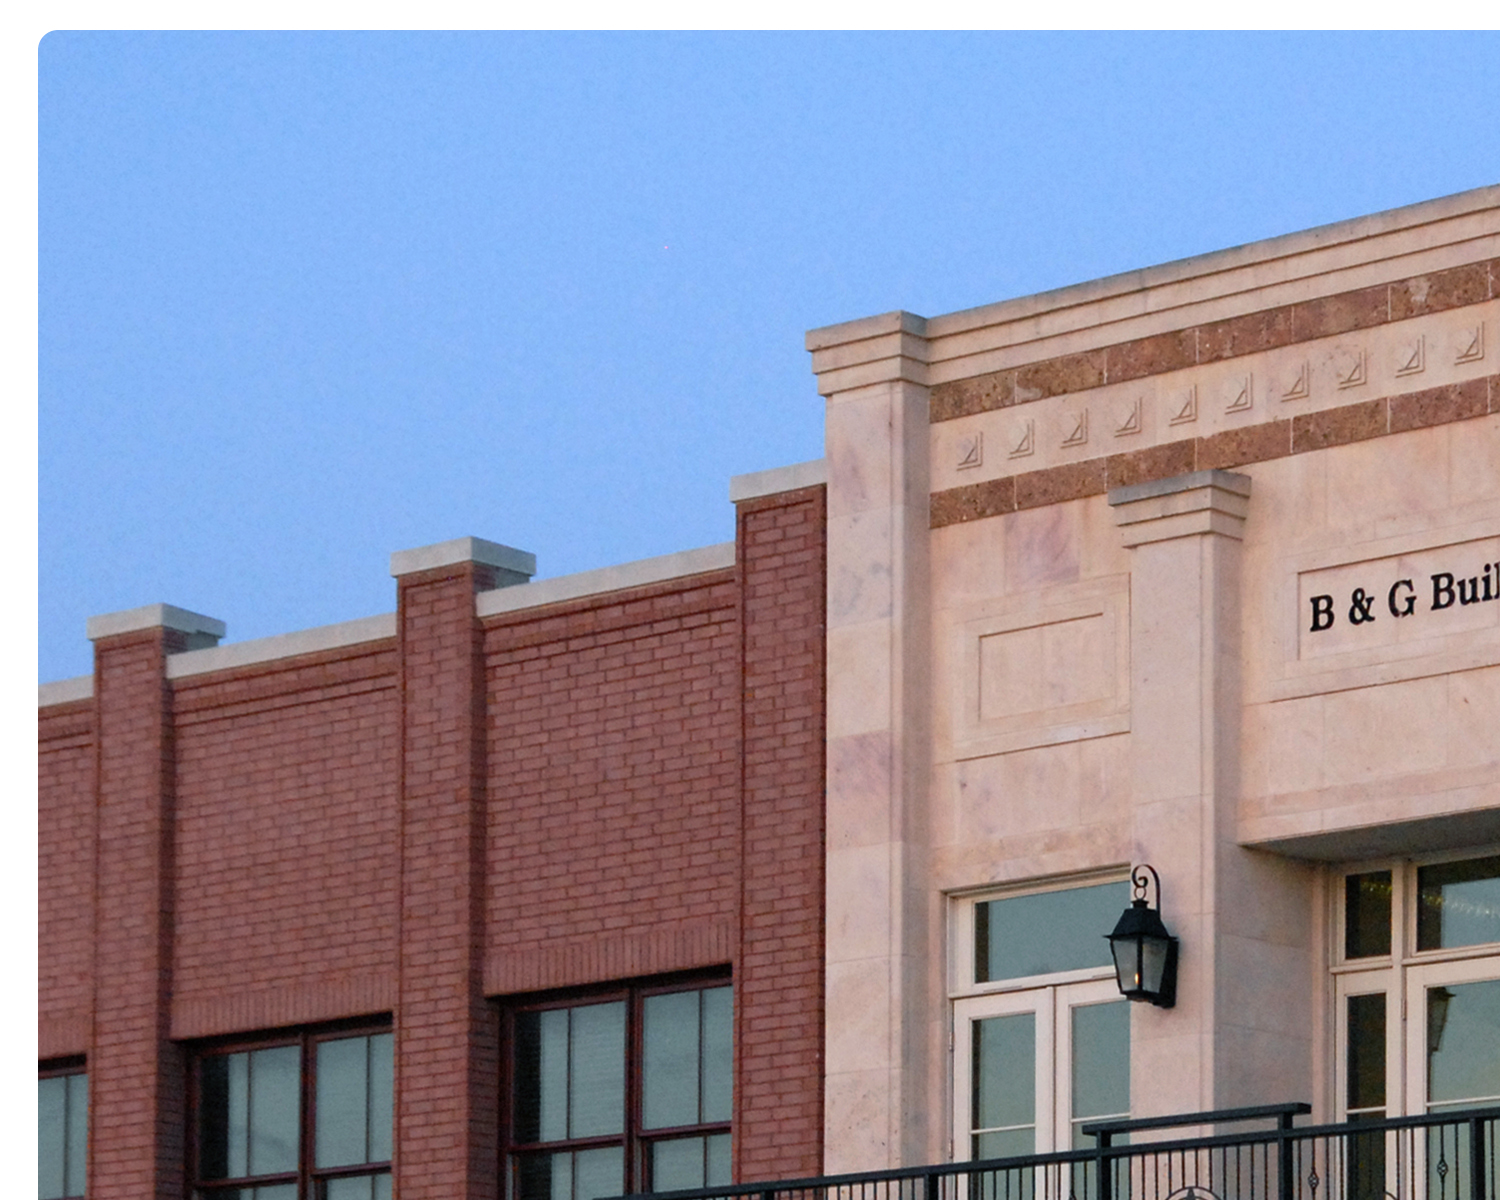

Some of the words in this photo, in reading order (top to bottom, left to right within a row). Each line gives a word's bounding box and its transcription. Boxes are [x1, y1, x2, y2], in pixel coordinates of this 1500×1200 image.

[1310, 595, 1335, 632] B
[1348, 587, 1376, 625] &
[1388, 579, 1418, 618] G
